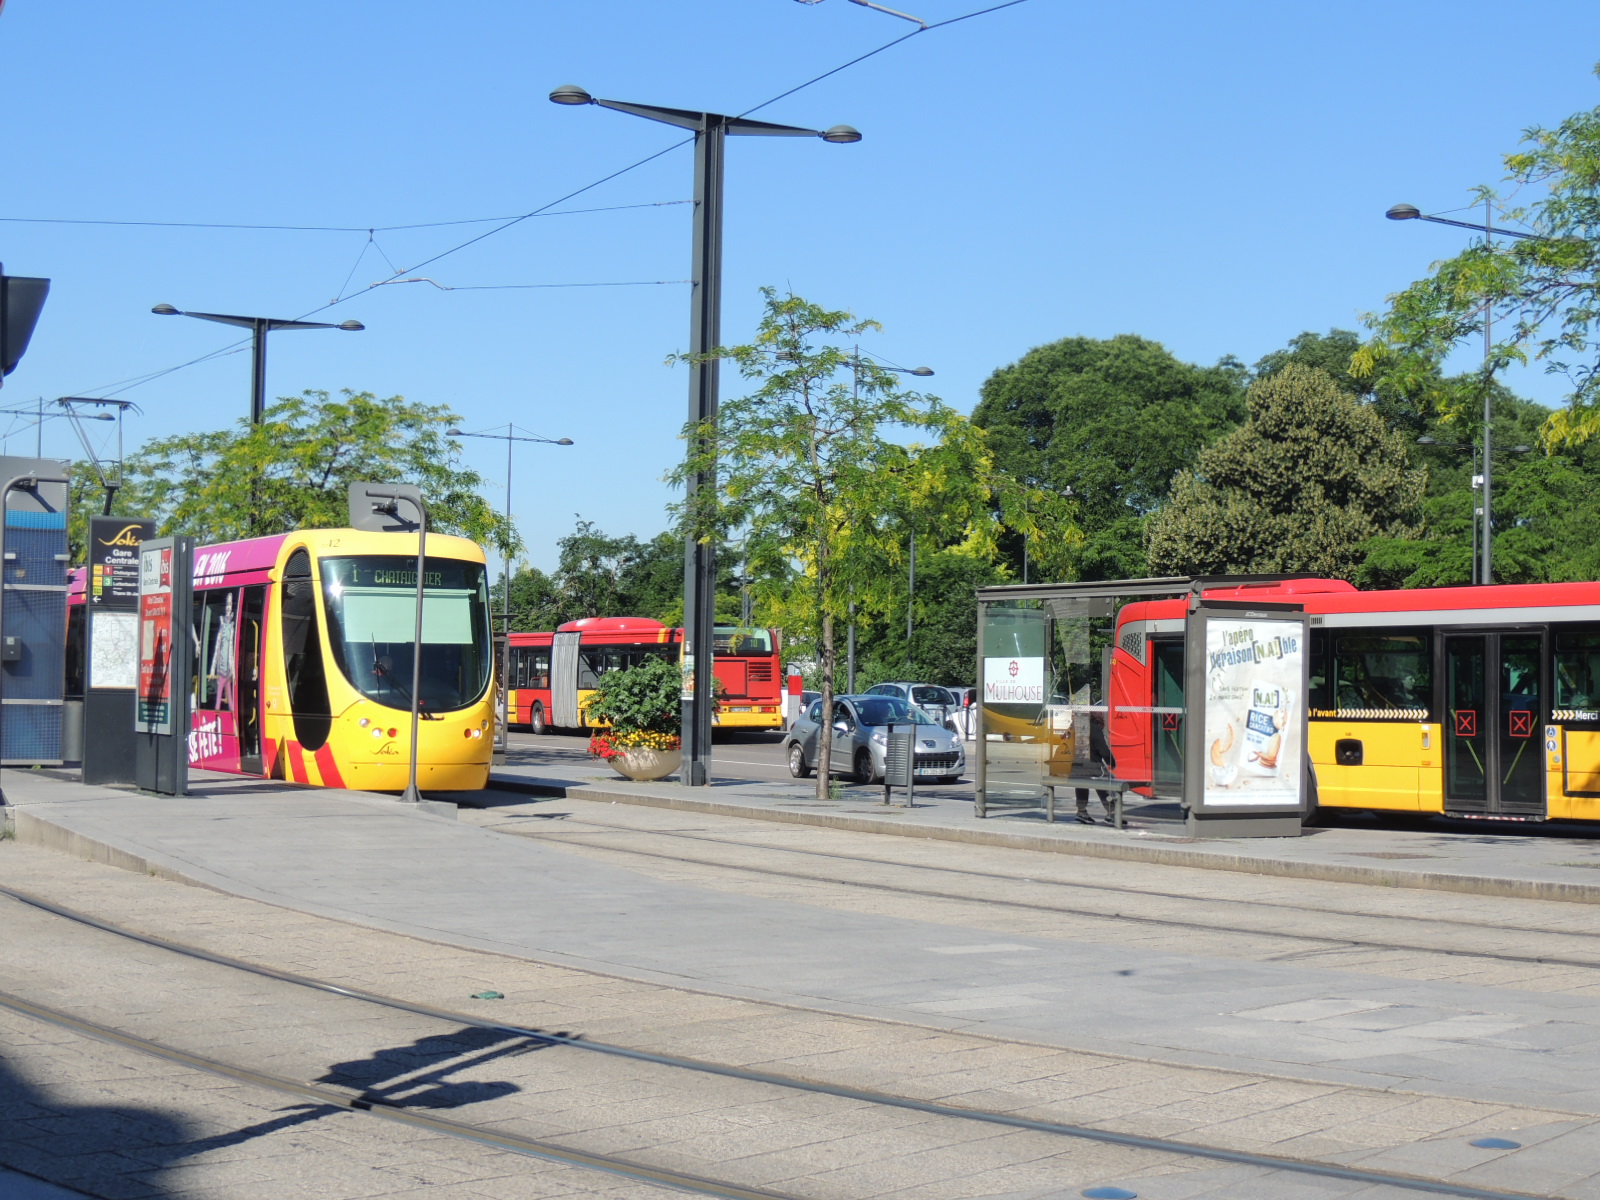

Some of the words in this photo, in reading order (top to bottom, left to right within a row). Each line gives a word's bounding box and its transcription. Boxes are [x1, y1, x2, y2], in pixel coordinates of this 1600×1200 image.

[105, 556, 139, 565] Centrale
[112, 549, 133, 557] Gare
[143, 554, 153, 573] ibis
[161, 559, 169, 574] ibis
[374, 569, 442, 586] CHATAIGIER
[750, 638, 758, 648] 10
[1222, 626, 1254, 647] l'apéro
[985, 682, 1042, 701] MULHOUSE
[1250, 711, 1270, 726] RICE
[1313, 708, 1337, 717] l'avant
[1575, 710, 1598, 720] Merci
